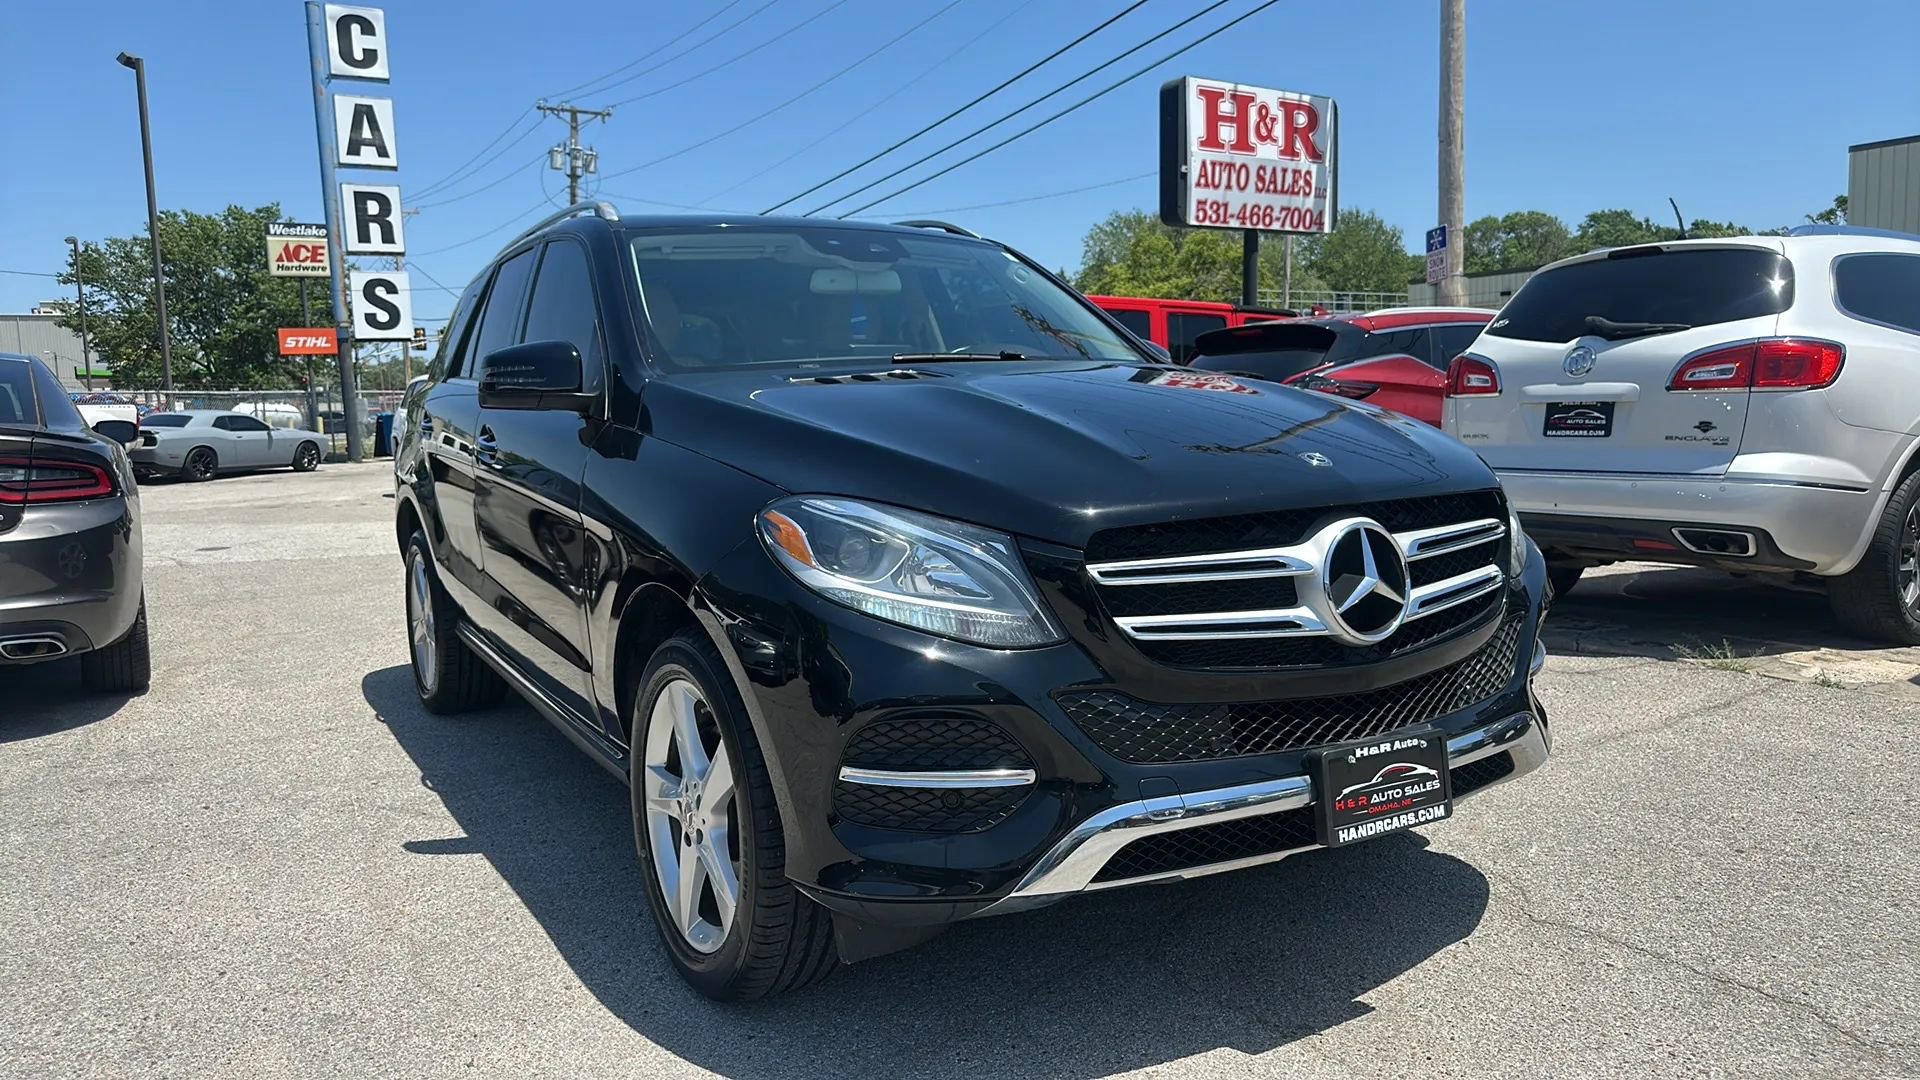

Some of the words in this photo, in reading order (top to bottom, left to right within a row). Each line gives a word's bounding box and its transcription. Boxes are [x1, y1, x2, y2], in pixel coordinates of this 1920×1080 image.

[1197, 86, 1323, 162] H&R
[335, 14, 402, 331] CARS
[1195, 160, 1250, 191] AUTO
[1255, 163, 1313, 198] SALES
[1195, 199, 1325, 230] 531-466-7004
[269, 224, 327, 236] Westlake
[276, 242, 325, 263] ACE
[276, 263, 327, 272] Hardware
[284, 336, 331, 348] STIHL
[1355, 742, 1392, 758] H&R
[1393, 738, 1419, 751] Auto
[1370, 789, 1402, 804] AUTO
[1405, 780, 1441, 796] SALES
[1338, 805, 1446, 843] HANDRCARS.COM
